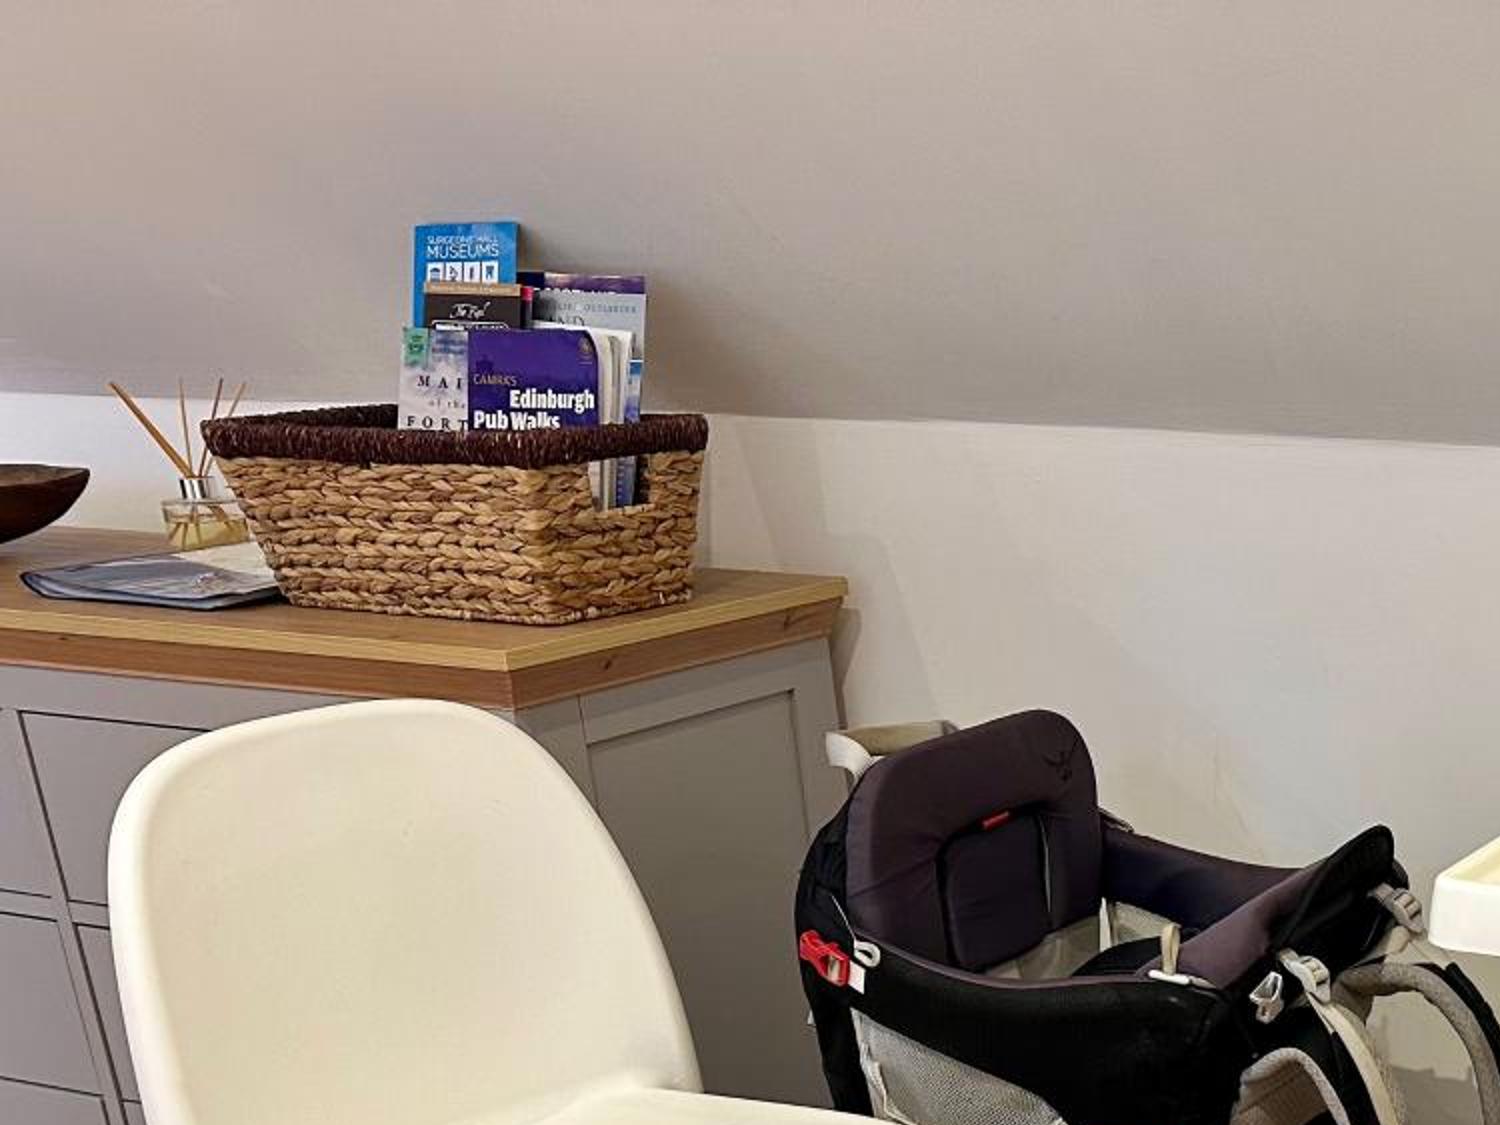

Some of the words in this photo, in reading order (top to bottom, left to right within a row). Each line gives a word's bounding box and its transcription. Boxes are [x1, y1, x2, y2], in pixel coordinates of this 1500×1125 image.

[427, 243, 499, 259] MUSEUMS
[509, 388, 595, 414] Edinburgh
[473, 409, 509, 429] Pub
[510, 411, 561, 430] Walks
